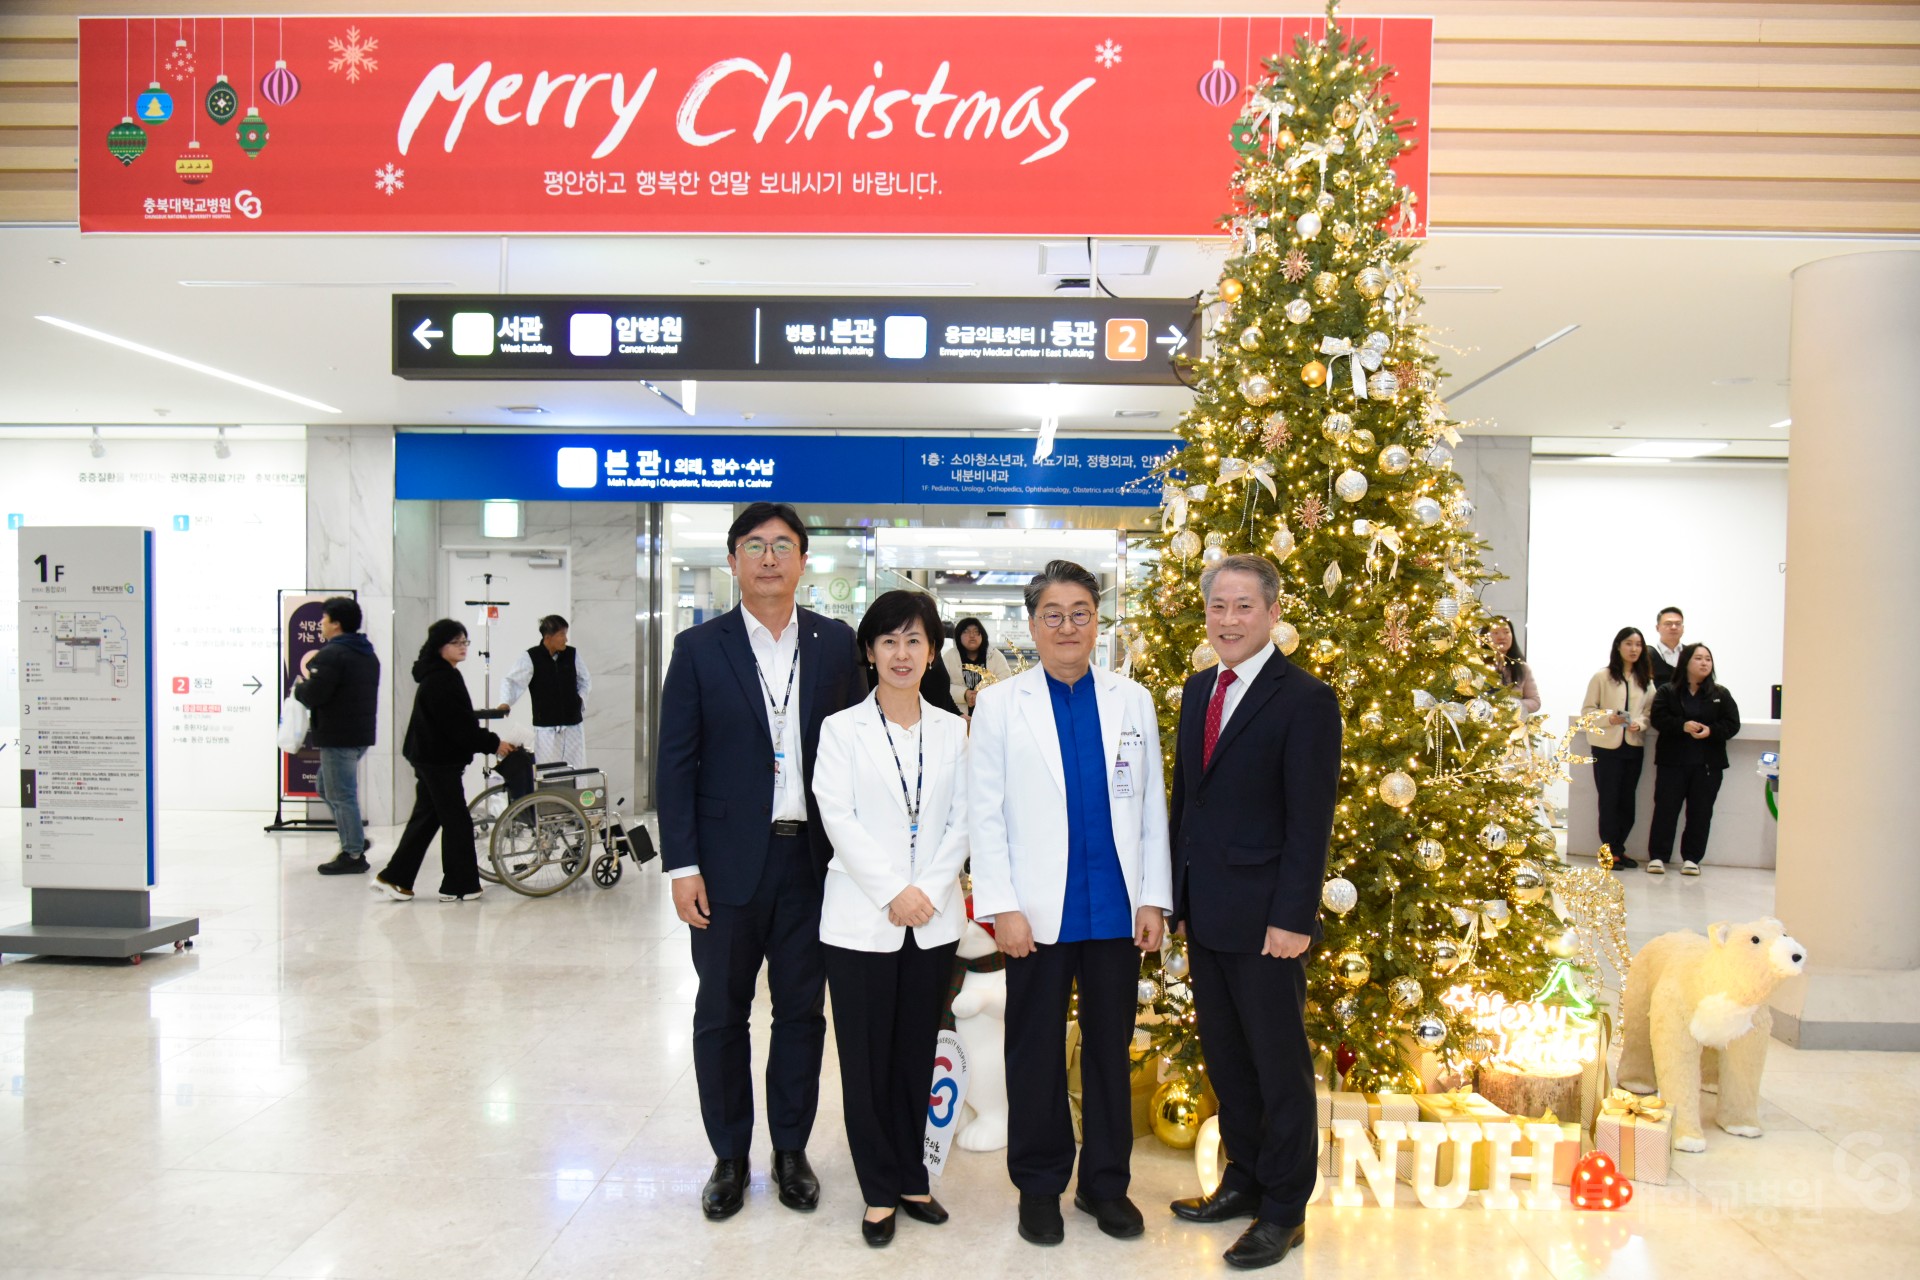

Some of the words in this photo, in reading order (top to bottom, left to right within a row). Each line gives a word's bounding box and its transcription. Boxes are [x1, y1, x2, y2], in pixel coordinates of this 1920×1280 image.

[396, 59, 658, 160] Merry
[676, 51, 1097, 166] Christmas
[543, 170, 627, 196] 평안하고
[636, 170, 700, 195] 행복한
[709, 170, 751, 195] 연말
[759, 171, 842, 195] 보내시기
[852, 171, 943, 198] 바랍니다.
[143, 197, 231, 213] 충북대학교병원
[497, 316, 543, 341] 서관
[615, 316, 682, 342] 암병원
[786, 324, 816, 343] 병동
[830, 318, 877, 344] 본관
[944, 325, 1035, 344] 응급의료센터
[1050, 320, 1097, 346] 동관
[1117, 325, 1136, 353] 2
[619, 344, 645, 354] Cancer
[647, 344, 678, 355] Hospital
[794, 346, 815, 355] Ward
[822, 346, 841, 355] Main
[843, 346, 874, 357] Building
[939, 347, 981, 358] Emergency
[983, 347, 1013, 357] Medical
[1014, 348, 1040, 357] Center
[1045, 348, 1061, 357] East
[1063, 348, 1094, 359] Building
[604, 449, 630, 476] 본
[636, 449, 662, 476] 관
[951, 453, 1027, 468] 소아청소년과,
[1087, 454, 1136, 469] 정형외과,
[255, 473, 305, 484] 충북대학교병
[951, 469, 1009, 483] 내분비내과
[931, 485, 960, 493] Pediatrics,
[961, 485, 986, 493] Urology,
[987, 485, 1024, 494] Orthopedics,
[1025, 486, 1071, 494] Ophthalmology,
[1073, 486, 1101, 494] Obstetrics
[1102, 486, 1114, 494] and
[299, 621, 323, 631] 식당으
[177, 679, 185, 692] 2
[24, 705, 31, 715] 3
[24, 745, 31, 755] 2
[26, 784, 31, 794] 1
